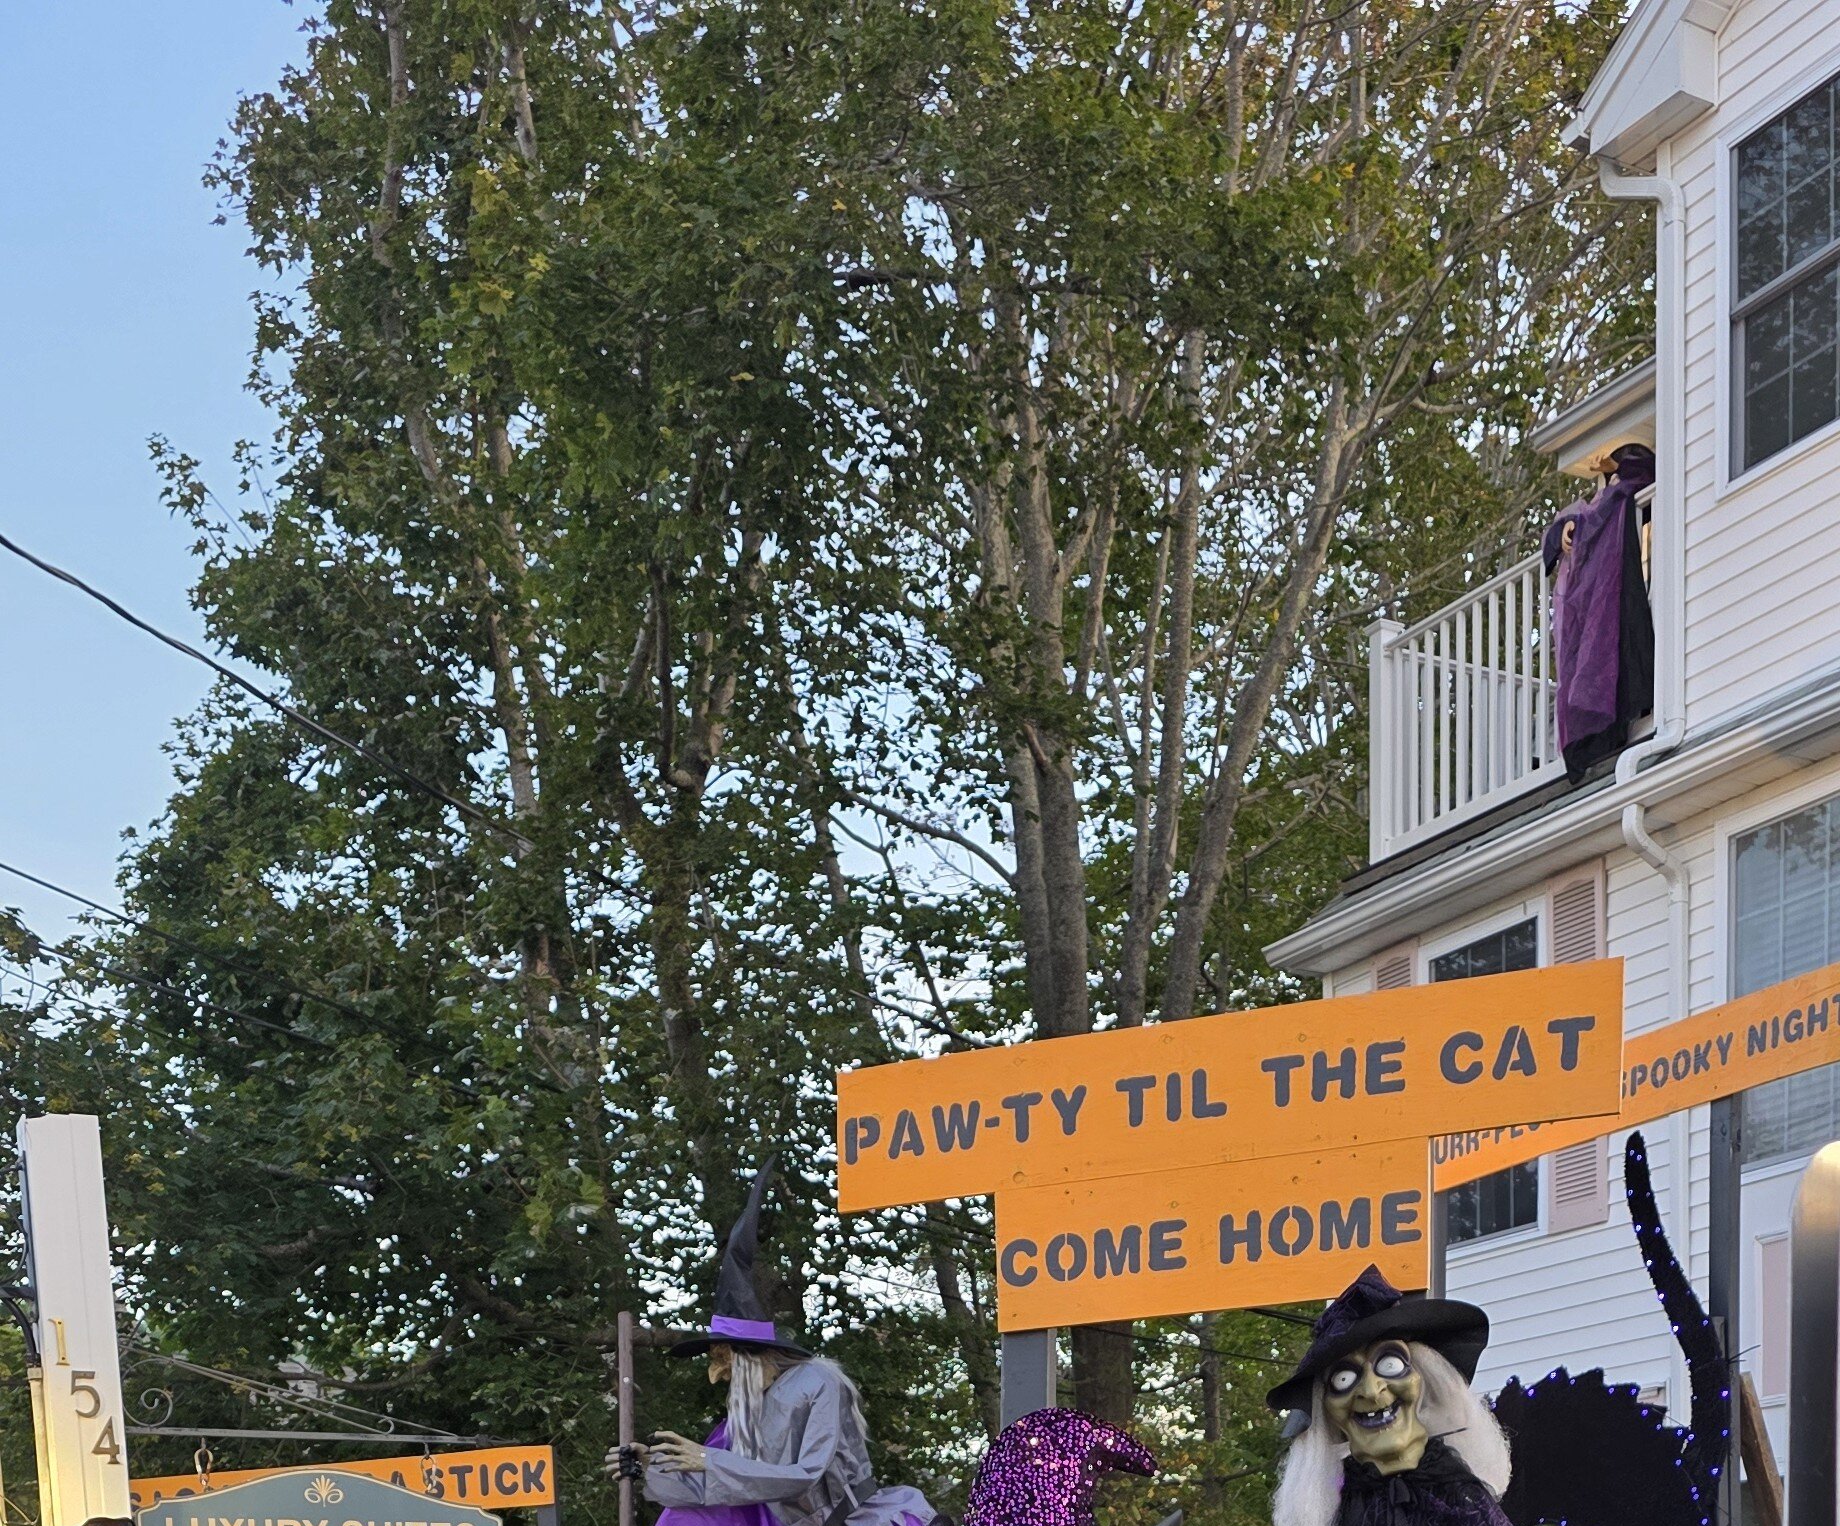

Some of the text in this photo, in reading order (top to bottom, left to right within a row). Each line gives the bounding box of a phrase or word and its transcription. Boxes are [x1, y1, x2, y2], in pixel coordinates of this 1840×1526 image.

[844, 1015, 1596, 1166] PAW-TY TIL THE CAT
[1000, 1189, 1422, 1288] COME HOME
[48, 1318, 122, 1465] 154
[424, 1459, 546, 1499] STICK
